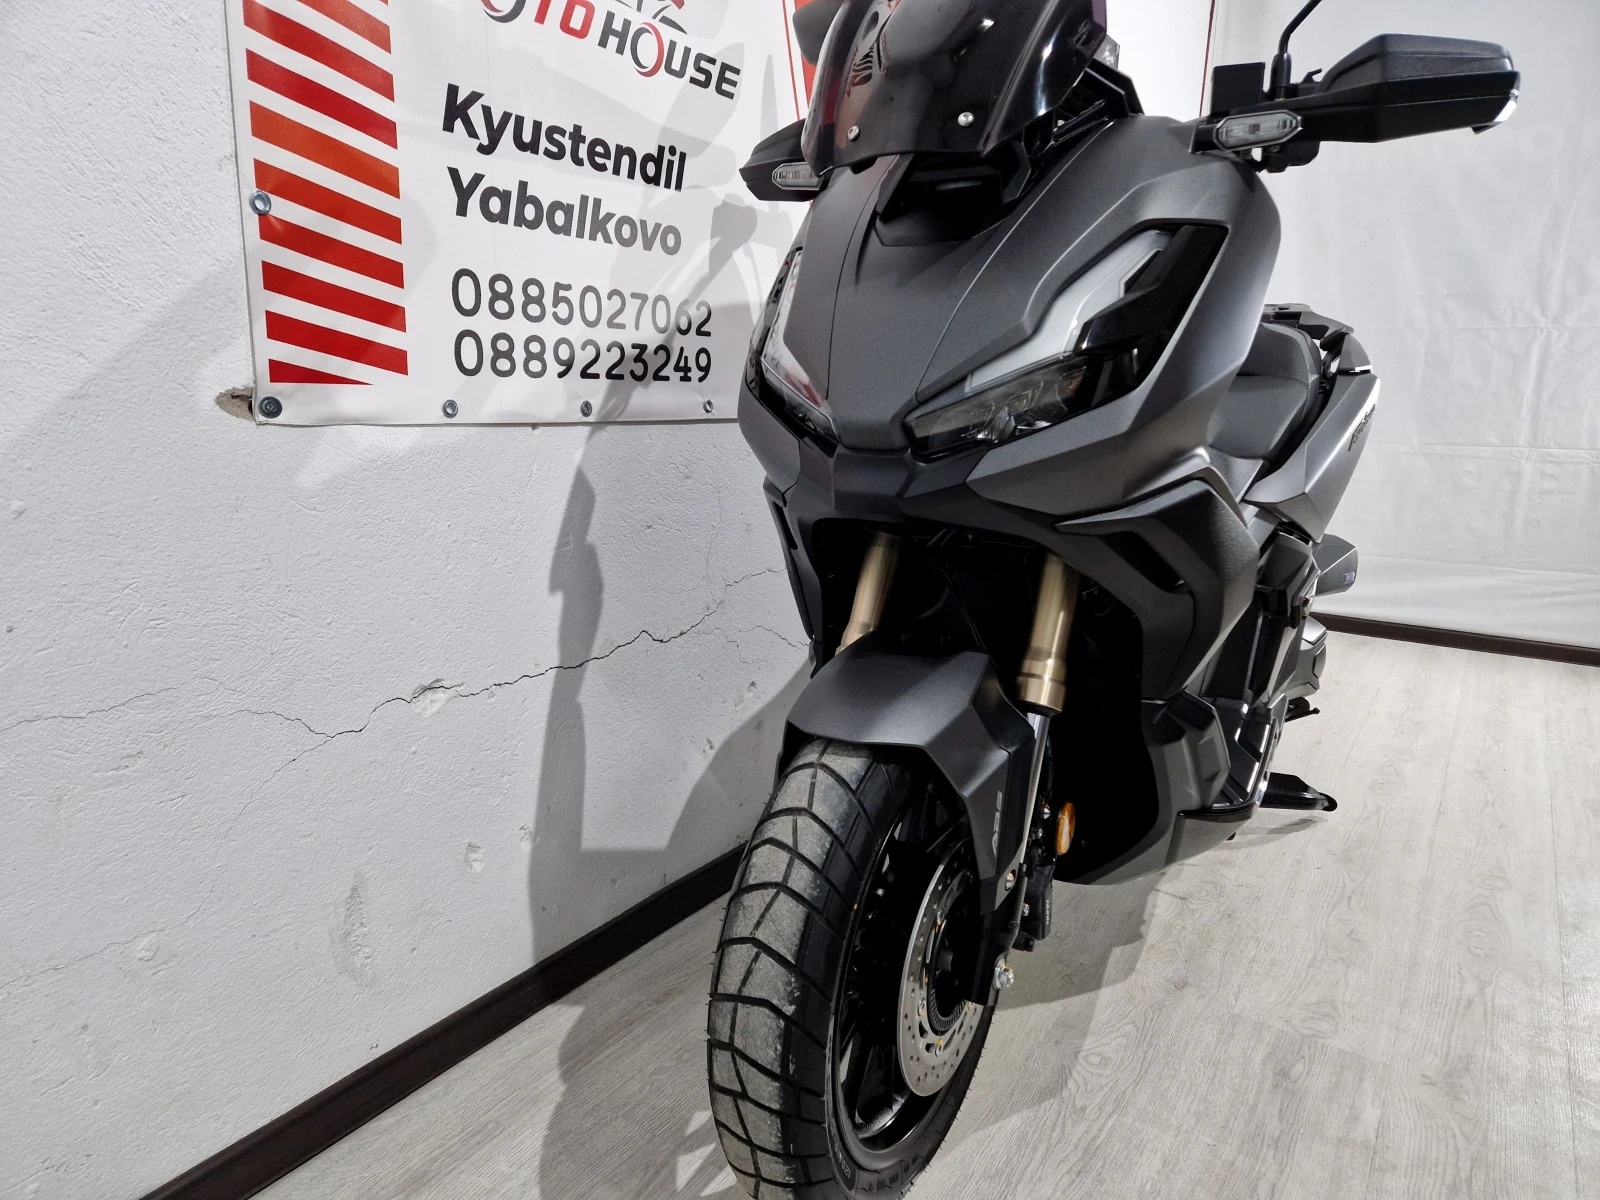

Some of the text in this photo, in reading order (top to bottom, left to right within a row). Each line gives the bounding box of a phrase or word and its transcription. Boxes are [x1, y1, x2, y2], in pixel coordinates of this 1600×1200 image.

[597, 9, 742, 101] HOUSE
[441, 82, 688, 193] Kyustendil
[446, 165, 682, 256] Yabalkovo
[451, 267, 713, 338] 0885027062
[453, 328, 713, 384] 0889223249
